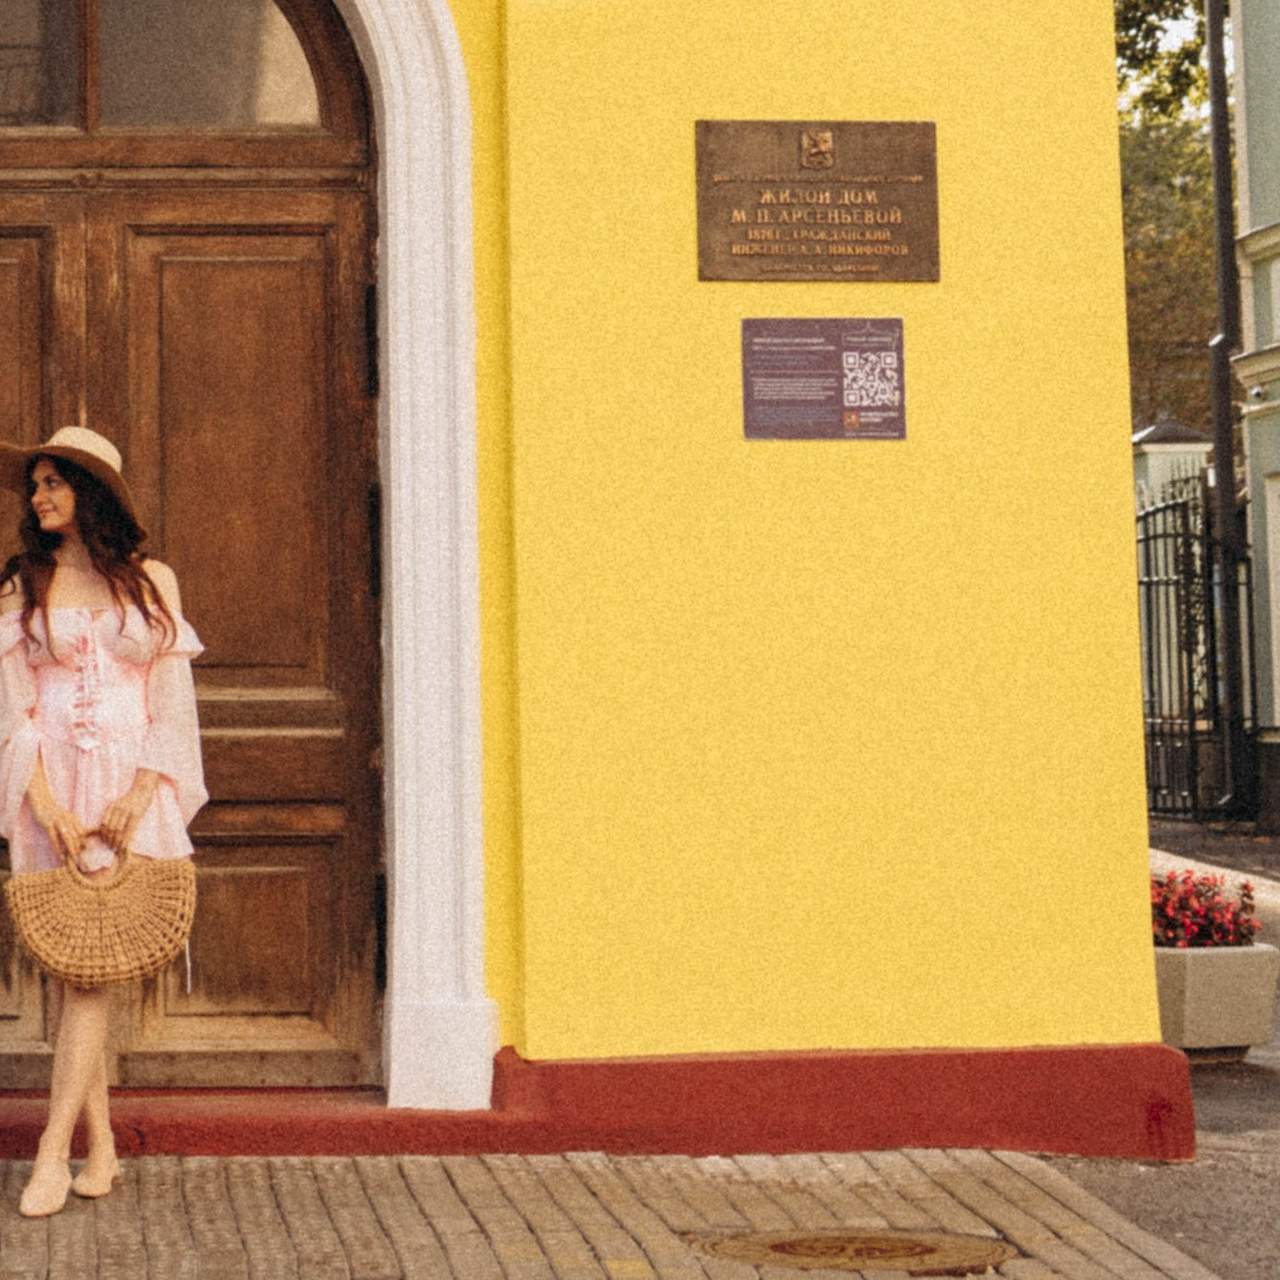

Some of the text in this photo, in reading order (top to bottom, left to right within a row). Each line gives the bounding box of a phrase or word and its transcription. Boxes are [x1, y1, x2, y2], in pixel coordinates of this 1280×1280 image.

[837, 189, 879, 205] ДОМ
[778, 206, 903, 224] АРСЕНЬЕВОЙ
[829, 244, 909, 256] НИКИФОРОВ
